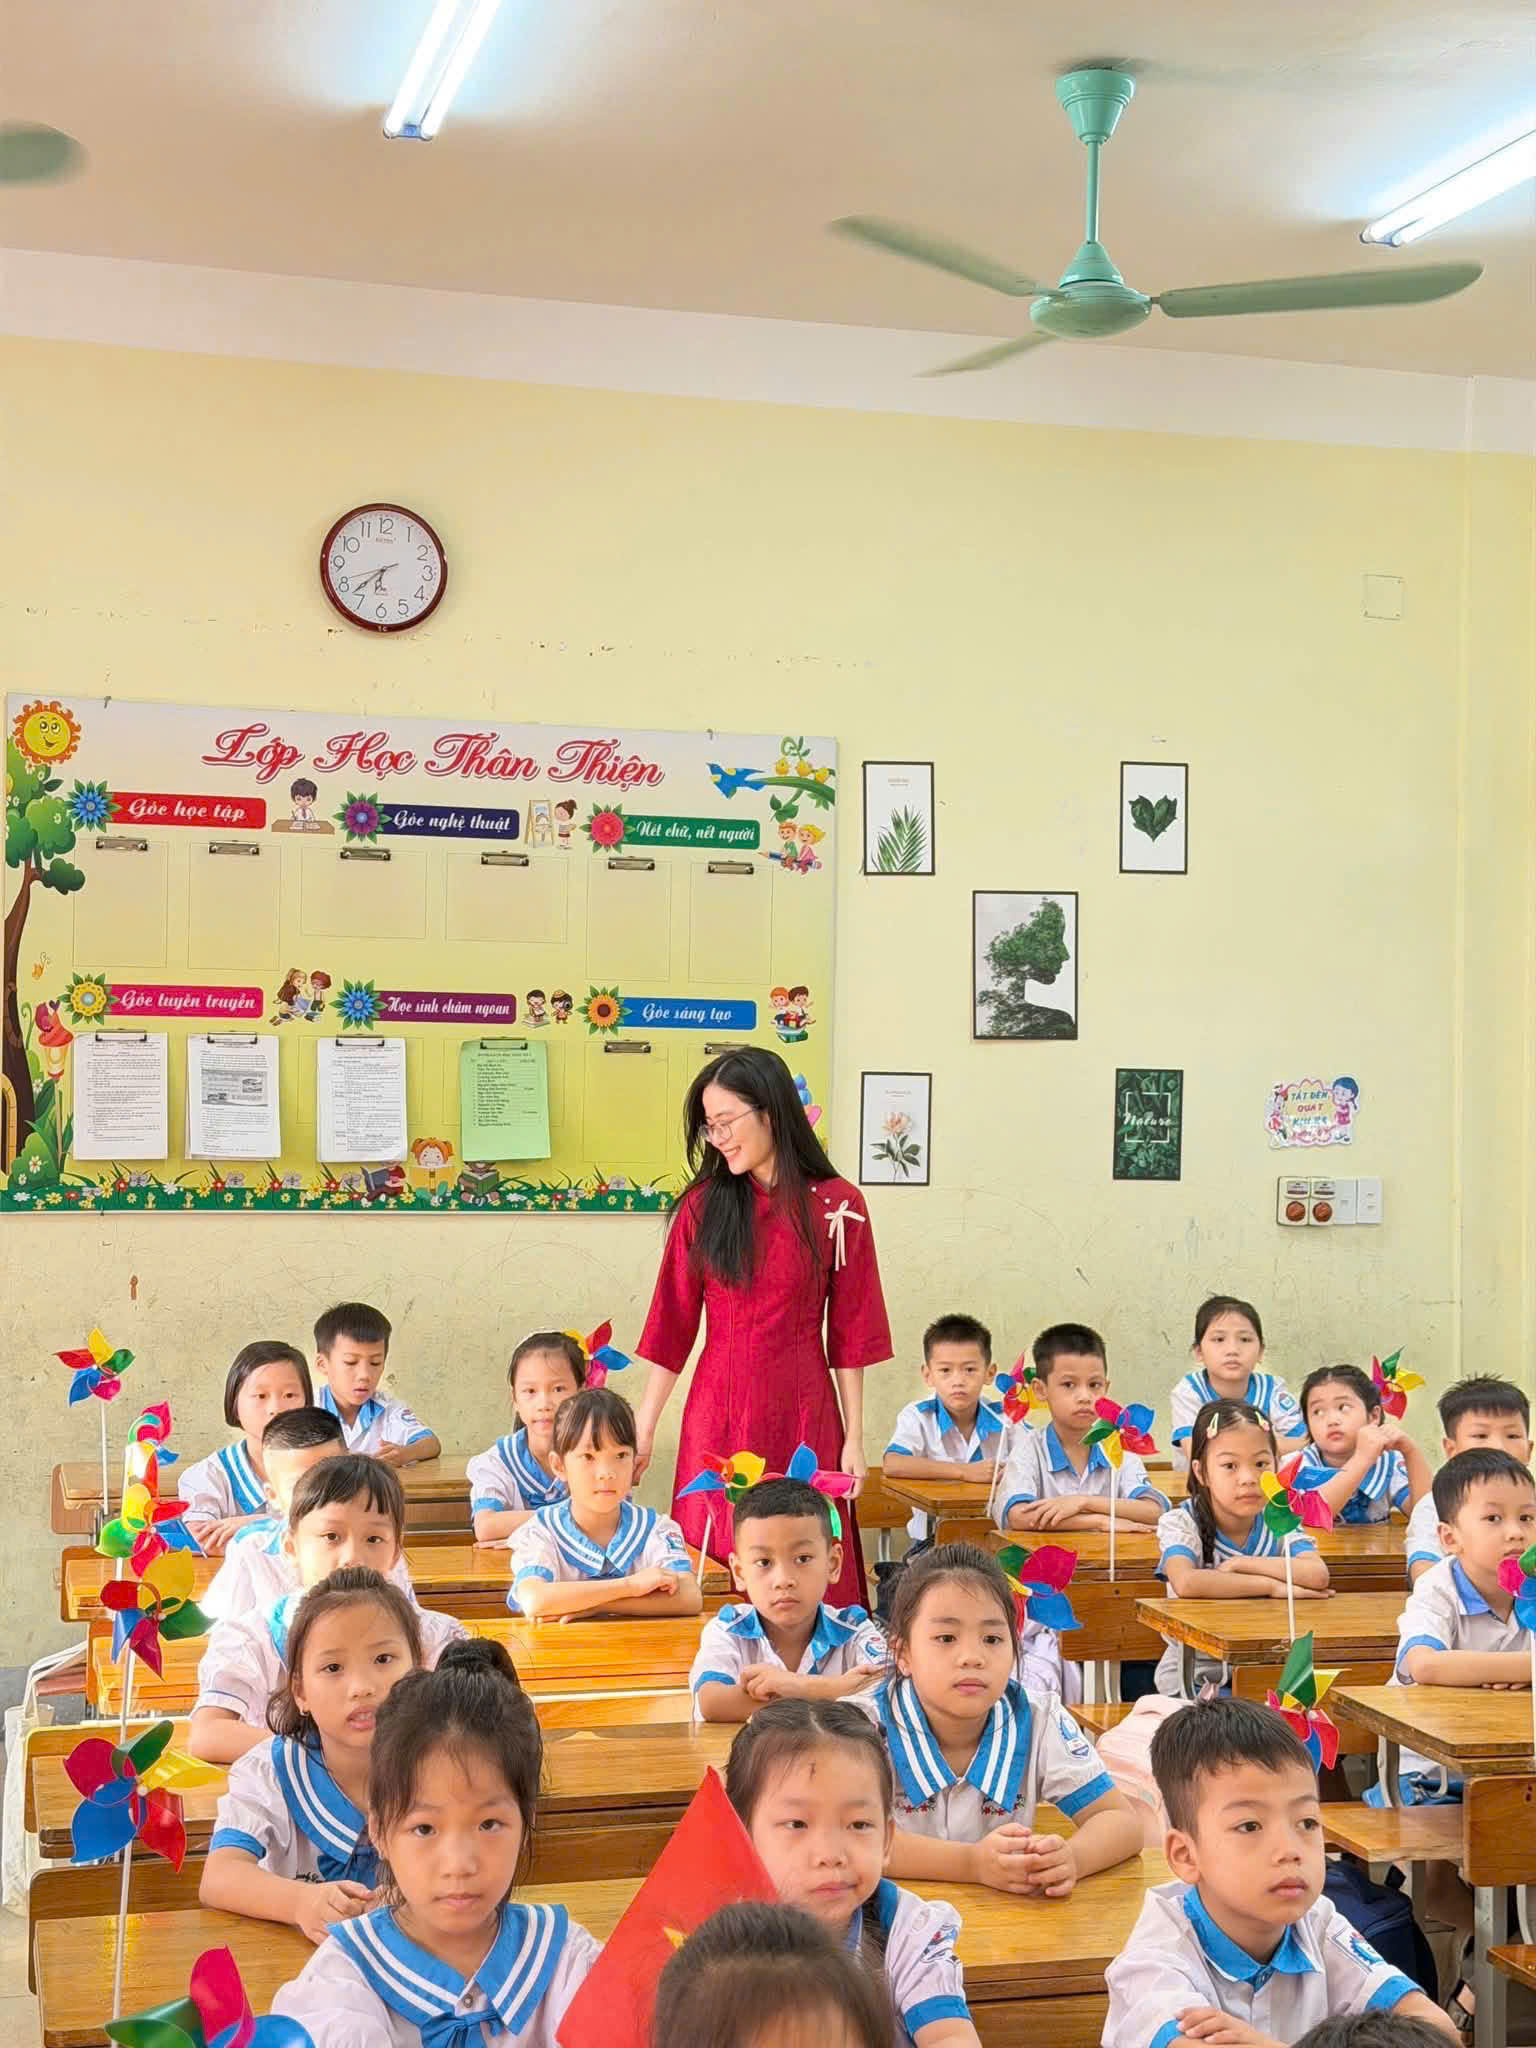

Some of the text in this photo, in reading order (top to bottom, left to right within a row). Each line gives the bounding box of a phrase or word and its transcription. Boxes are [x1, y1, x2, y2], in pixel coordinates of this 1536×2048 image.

[361, 520, 371, 538] 11
[379, 517, 394, 535] 12
[406, 525, 412, 542] 1
[342, 535, 360, 553] 10
[416, 544, 429, 562] 2
[332, 555, 346, 572] 9
[420, 565, 434, 581] 3
[338, 576, 350, 593] 8
[413, 585, 425, 601] 4
[352, 592, 366, 610] 7
[397, 599, 409, 615] 5
[375, 602, 387, 619] 6
[201, 722, 665, 792] Lớp Học Thân Thiện
[128, 798, 247, 822] Góc học tập
[393, 809, 512, 833] Góc nghệ thuật
[718, 827, 755, 843] người
[120, 990, 256, 1012] Góc tuyên truyền
[387, 997, 412, 1016] Học
[415, 998, 439, 1013] sinh
[475, 1004, 510, 1018] ngoan
[642, 1003, 732, 1023] Góc sáng tạo
